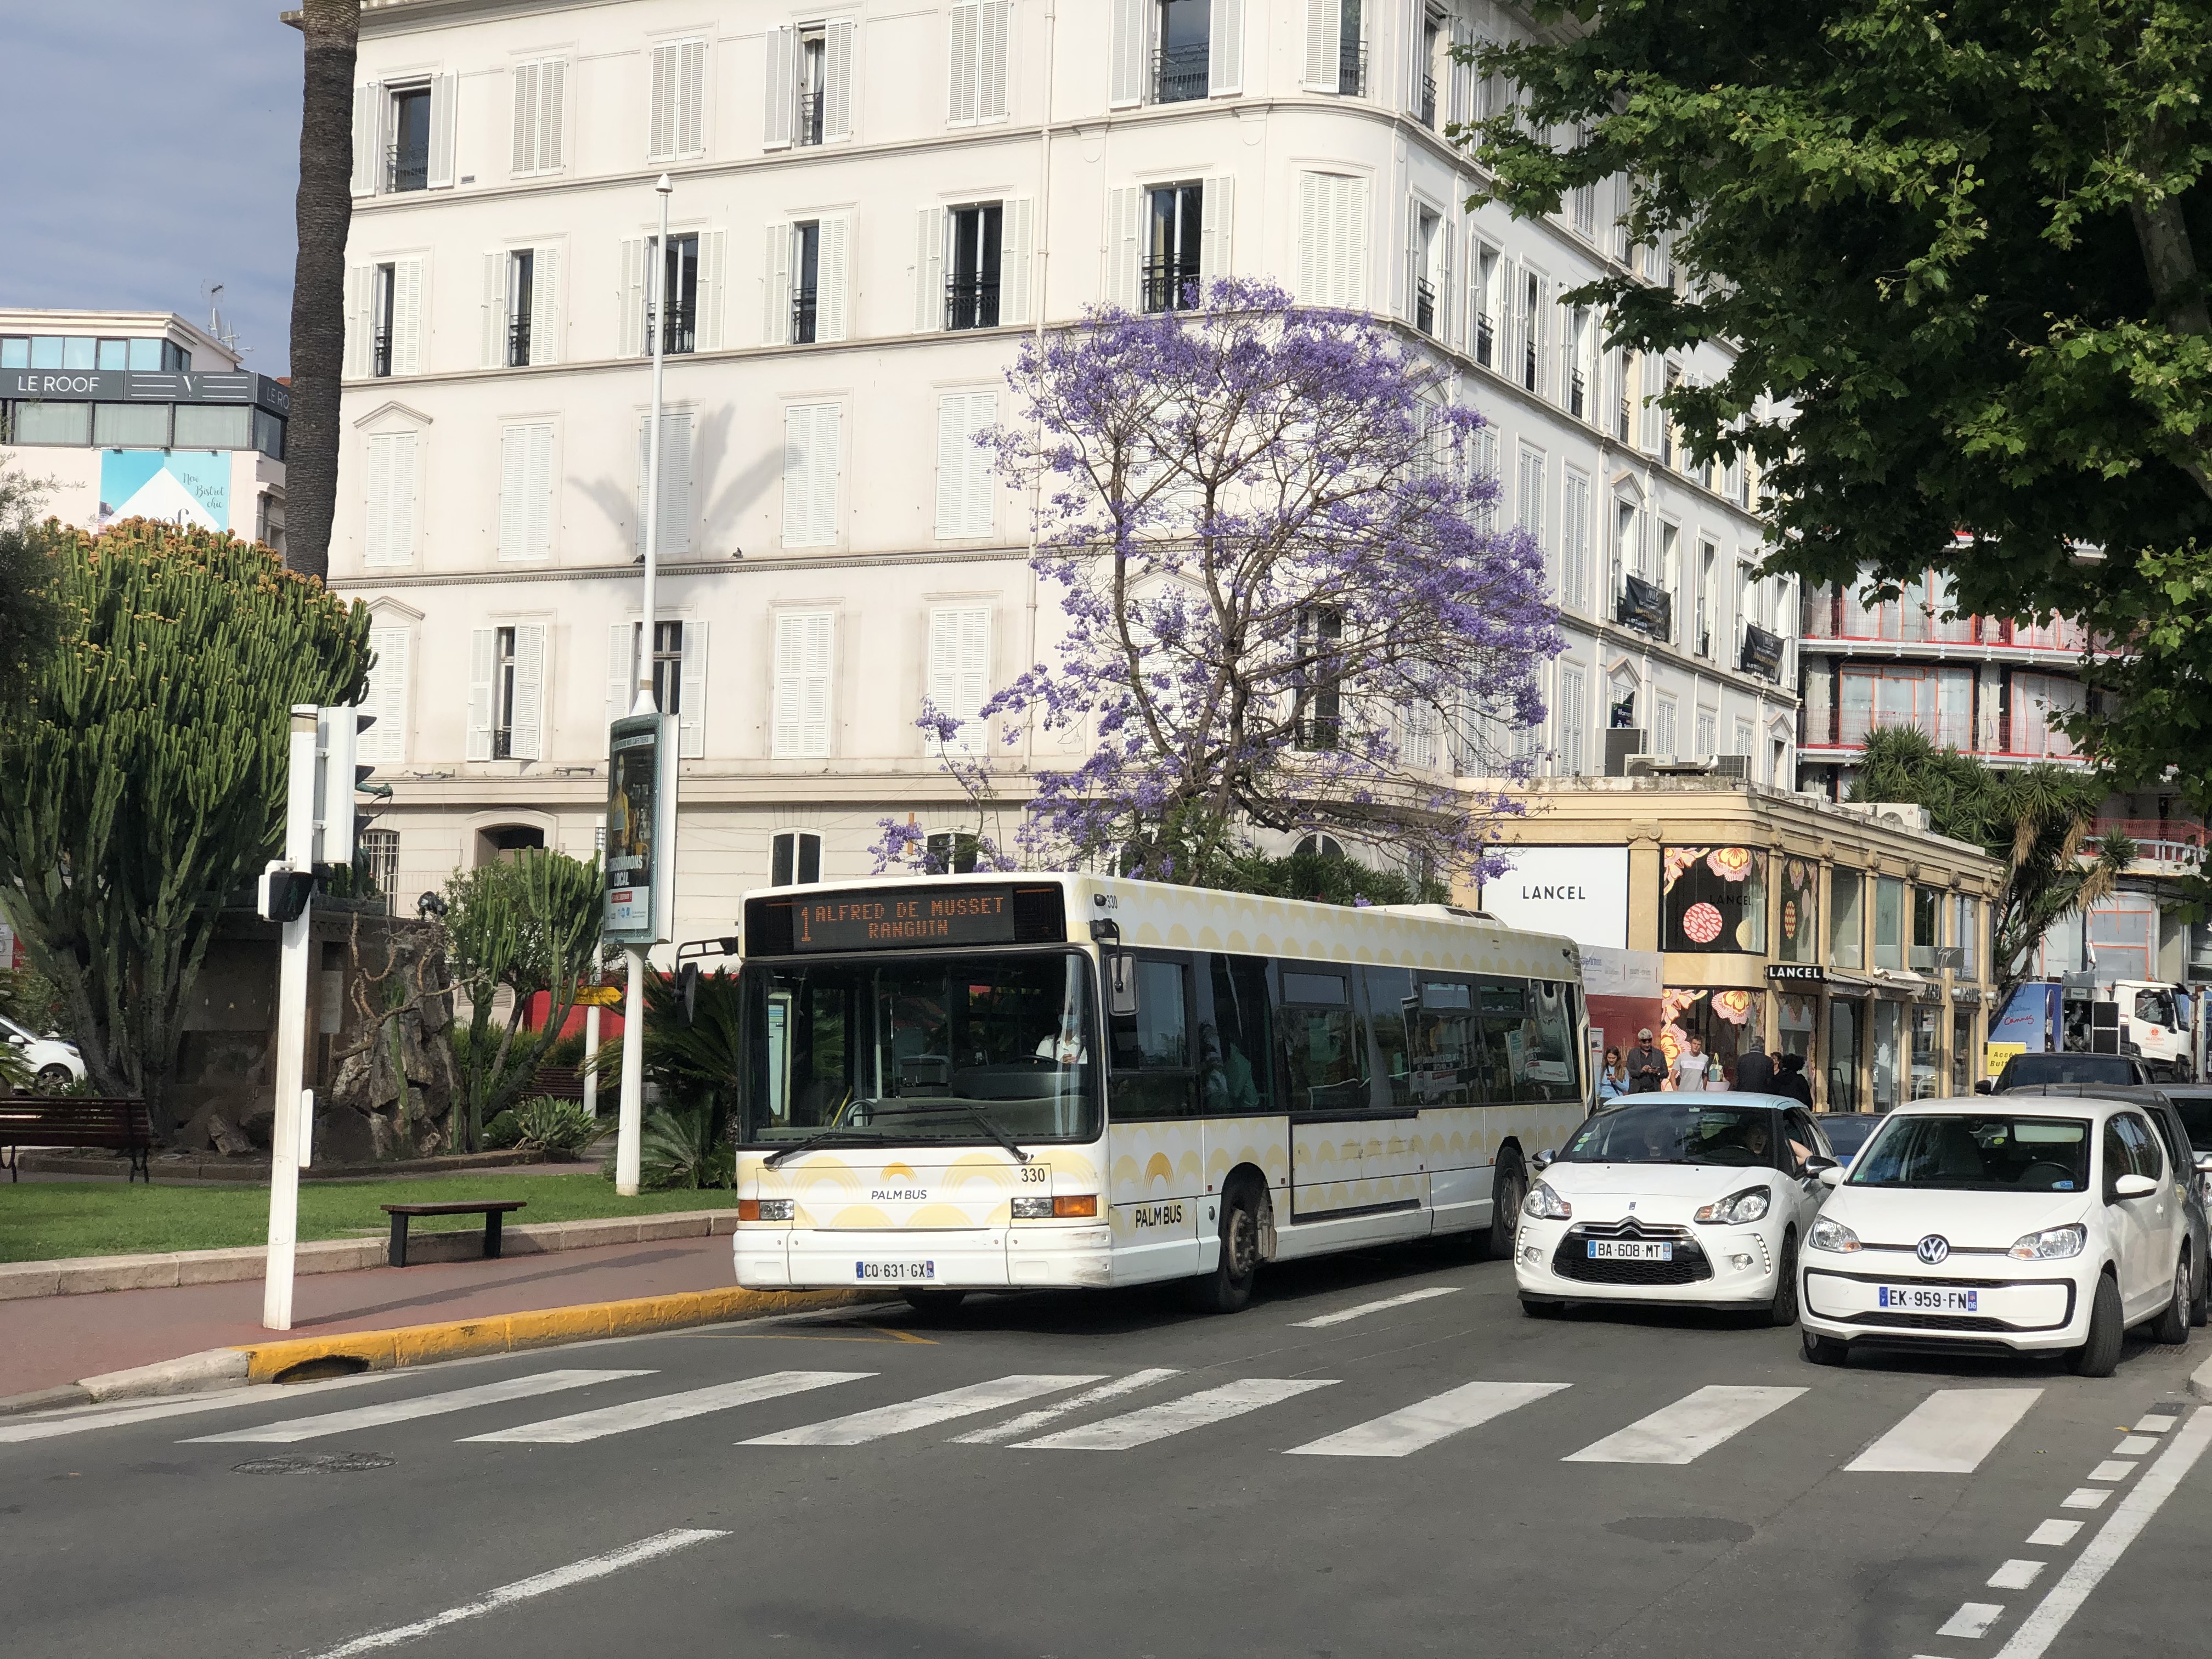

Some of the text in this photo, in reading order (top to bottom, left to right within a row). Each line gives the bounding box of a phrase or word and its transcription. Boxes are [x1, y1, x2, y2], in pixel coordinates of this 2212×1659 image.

[18, 376, 100, 392] LE ROOF
[267, 386, 290, 409] LE RO
[207, 496, 223, 509] chic
[613, 871, 629, 887] LOCAL
[1522, 885, 1586, 900] LANCEL
[1107, 895, 1118, 909] 330
[1709, 895, 1751, 906] LANCEL
[801, 896, 1003, 941] 1 ALFRED DE MUSSET
[868, 919, 948, 939] RANGUIN
[1769, 967, 1820, 978] LANCEL
[1020, 1167, 1046, 1182] 330
[871, 1189, 927, 1200] PALM BUS
[1136, 1204, 1182, 1228] PALM BUS
[1598, 1243, 1661, 1258] BA-608-MT
[1890, 1290, 1967, 1309] EK-959-FN
